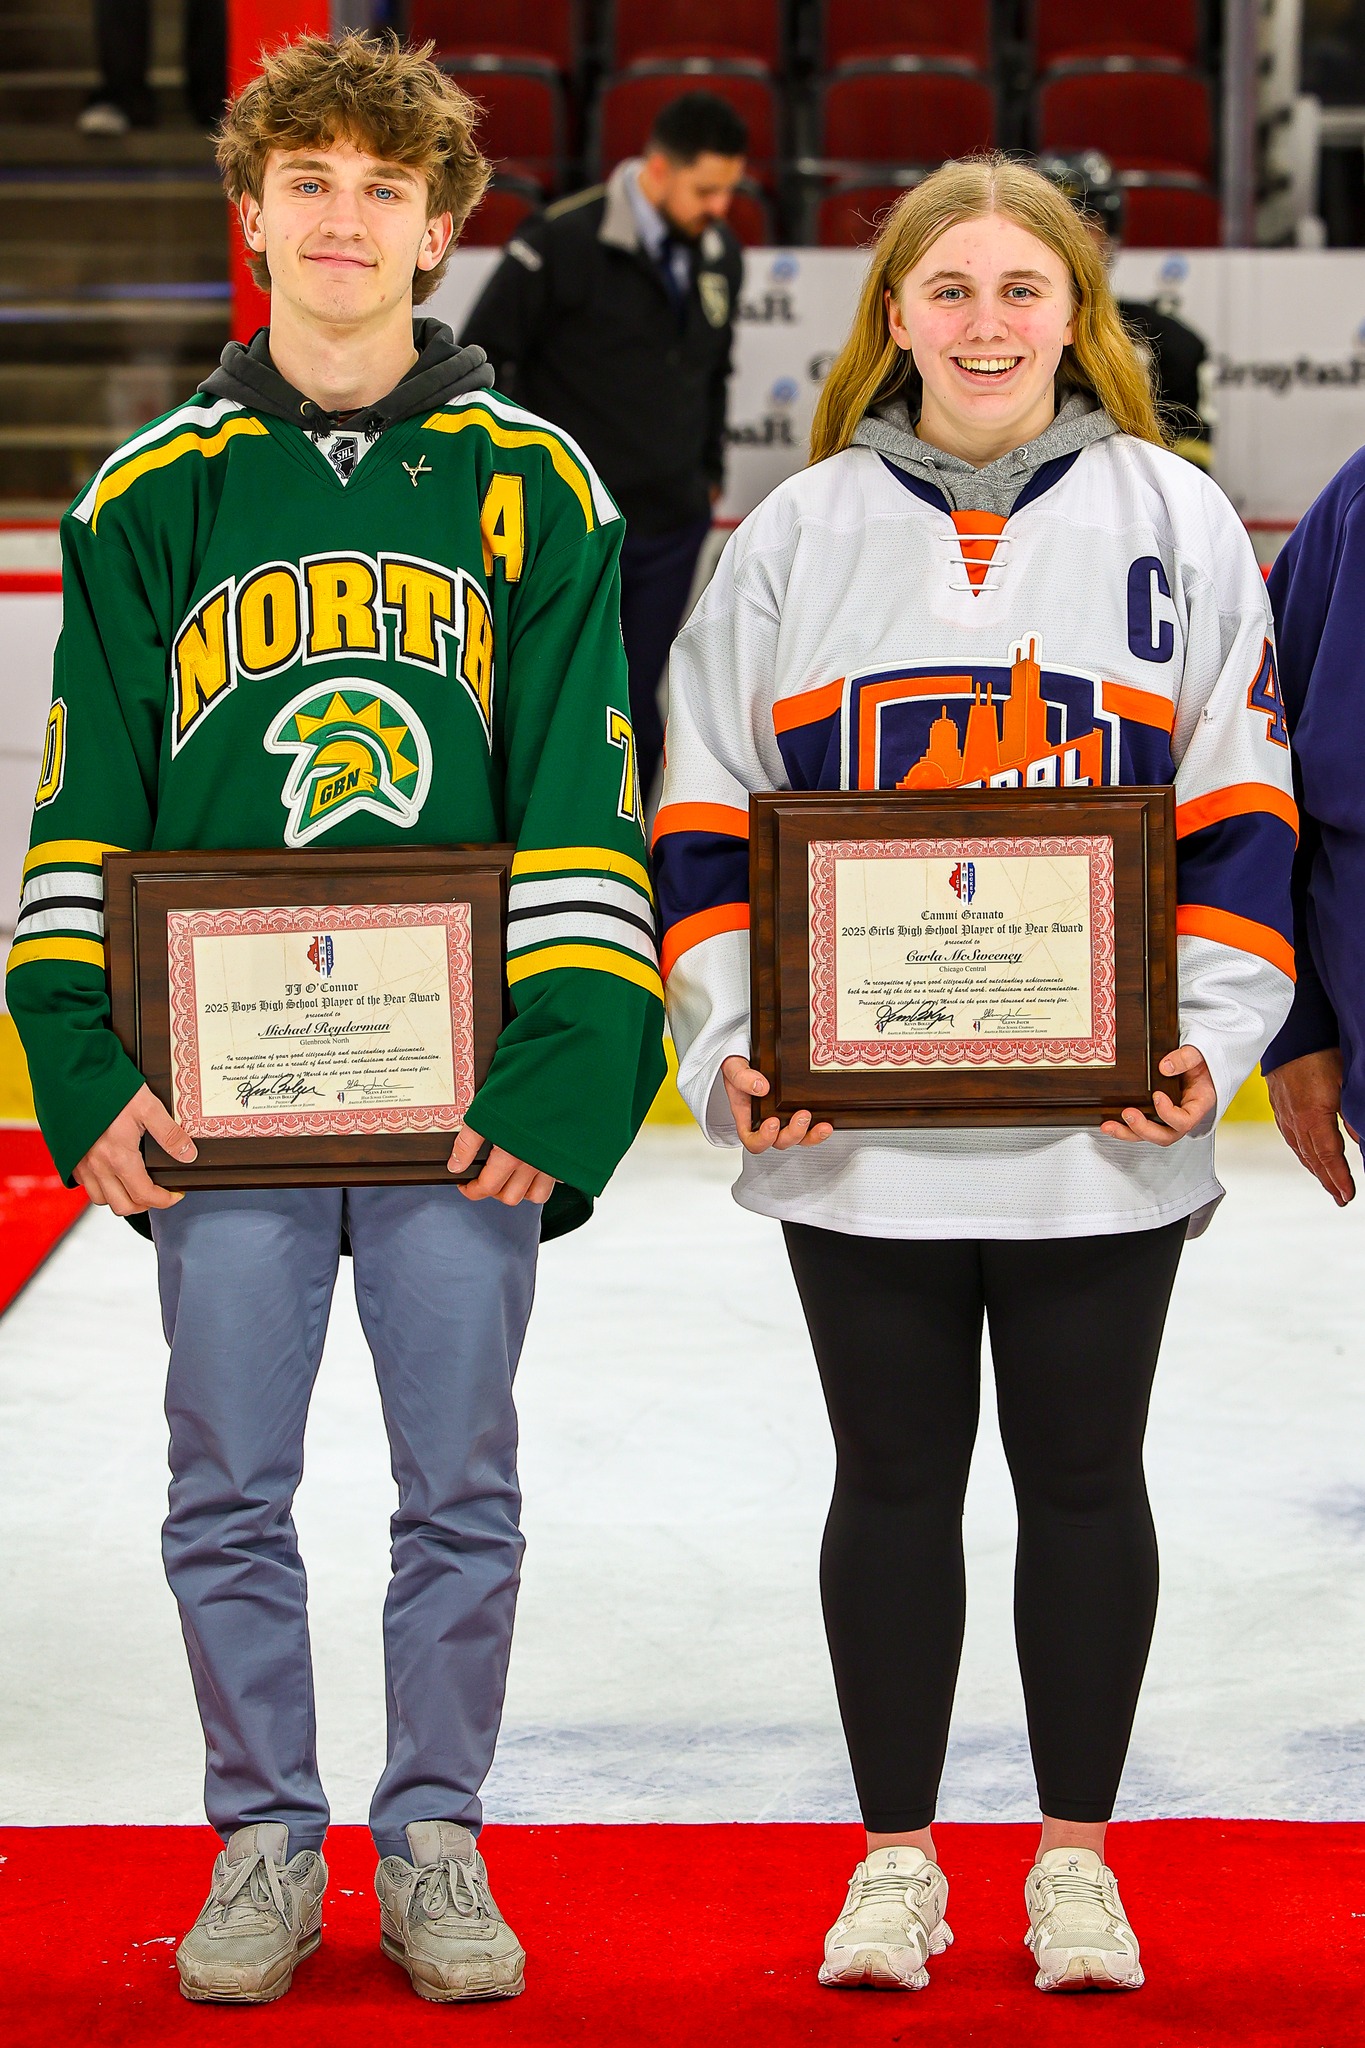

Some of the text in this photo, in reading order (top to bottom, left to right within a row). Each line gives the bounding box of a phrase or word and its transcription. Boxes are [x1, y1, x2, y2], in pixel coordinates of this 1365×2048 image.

[336, 448, 354, 461] SHL
[480, 472, 527, 583] A
[1127, 556, 1175, 663] C
[171, 550, 496, 761] NORTH
[320, 768, 361, 805] GBN
[921, 909, 1004, 920] Cammi Granato
[841, 922, 1084, 937] 2025 Girls High School Player of the Year Award
[906, 949, 1024, 964] Carla McSweeney
[306, 982, 359, 994] O'Connor
[205, 992, 440, 1014] 2025 Boys High School Player of the Year Award
[305, 1011, 334, 1019] presented
[258, 1020, 391, 1037] Michael Reyderman
[300, 1038, 331, 1046] Glenbrook
[235, 1054, 267, 1062] recognition
[305, 1050, 336, 1058] citizenship
[246, 1062, 256, 1070] off
[400, 1066, 418, 1074] twenty
